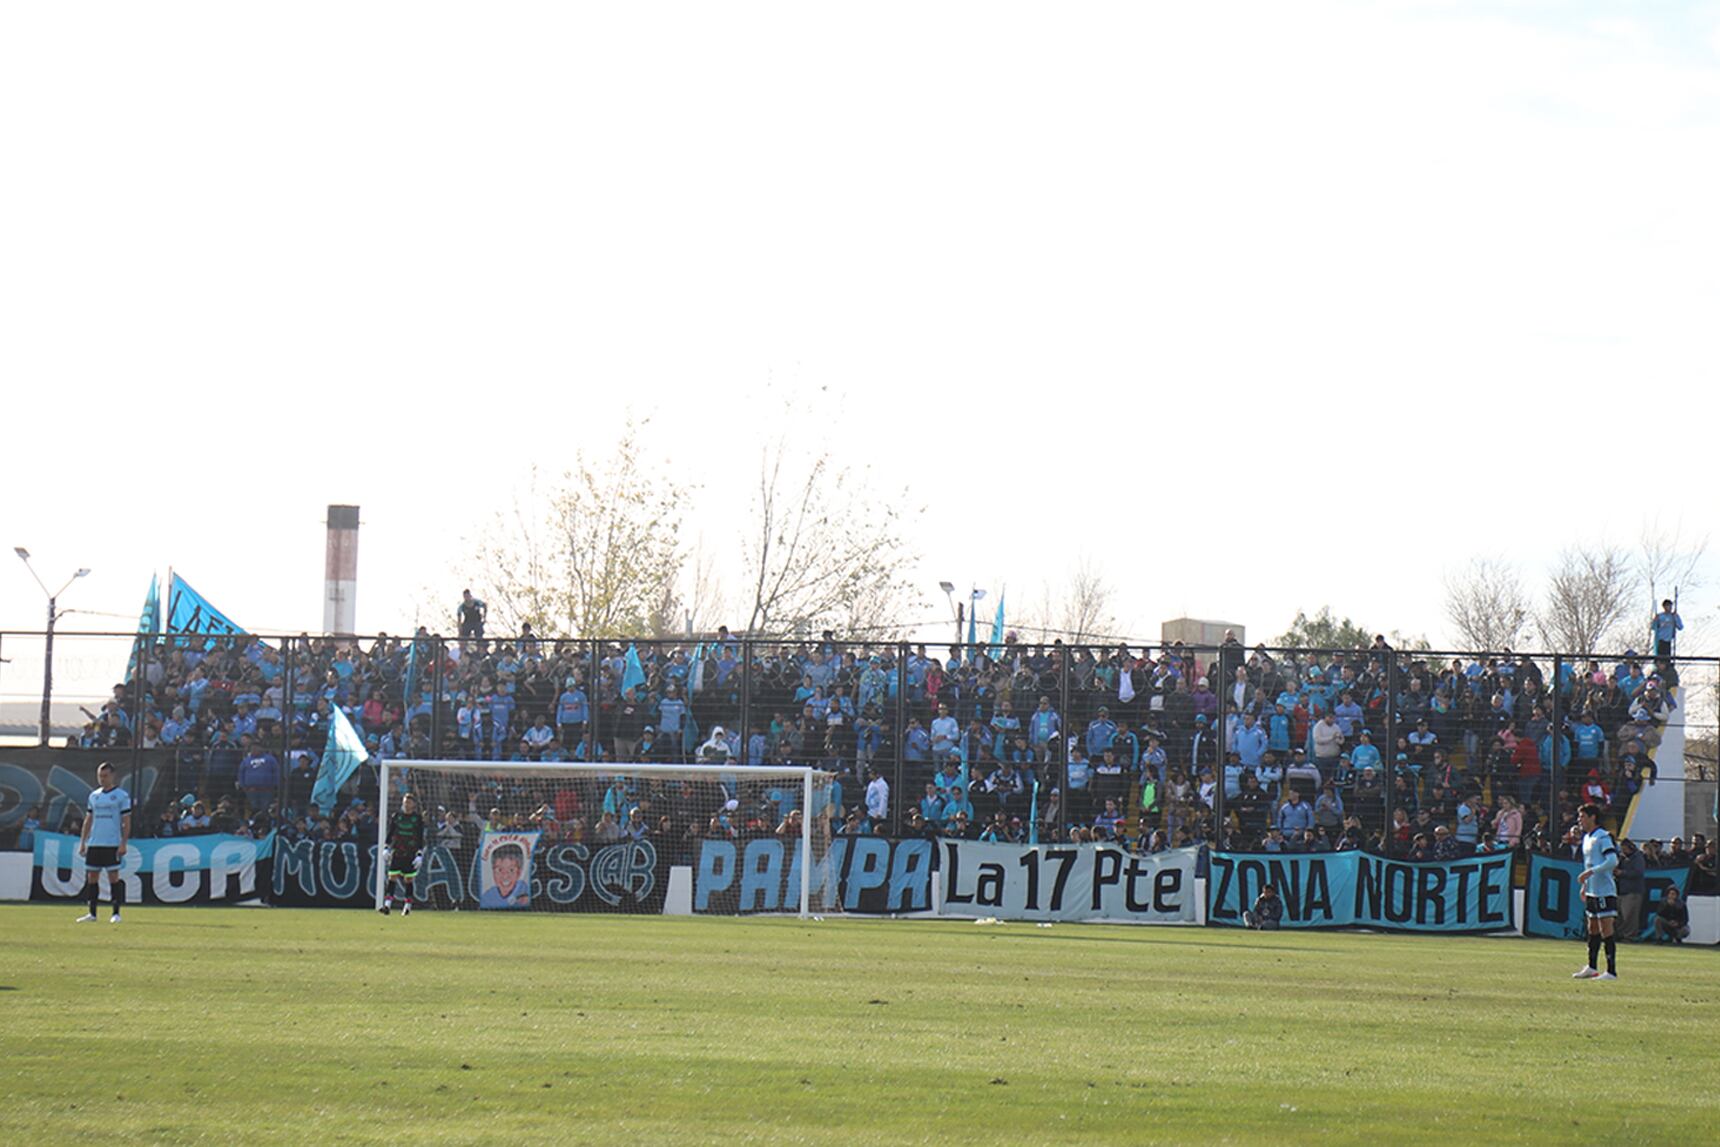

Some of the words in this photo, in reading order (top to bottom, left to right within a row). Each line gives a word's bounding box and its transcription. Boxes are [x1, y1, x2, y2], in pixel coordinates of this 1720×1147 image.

[695, 838, 933, 911] PAMPA
[945, 843, 1006, 907] La
[1020, 848, 1078, 911] 17
[1091, 848, 1183, 913] Pte
[1211, 857, 1334, 923] ZONA
[1354, 857, 1506, 925] NORTE
